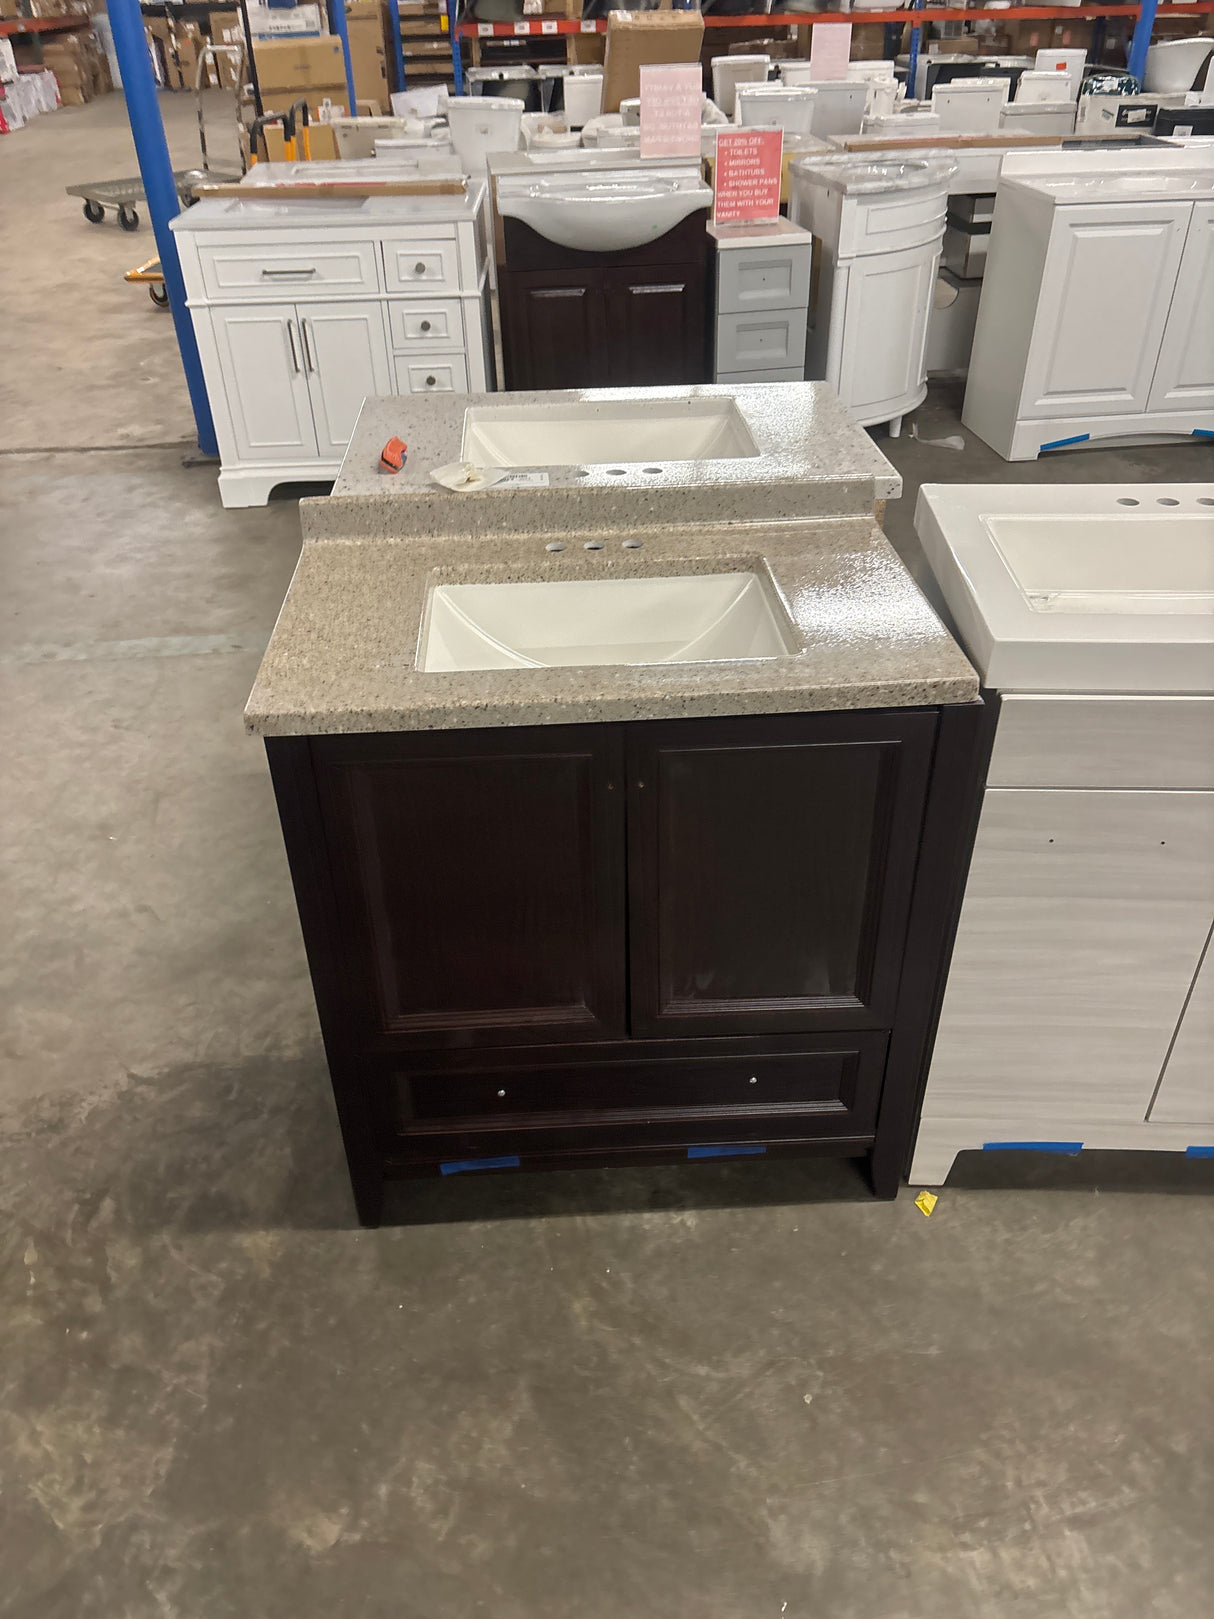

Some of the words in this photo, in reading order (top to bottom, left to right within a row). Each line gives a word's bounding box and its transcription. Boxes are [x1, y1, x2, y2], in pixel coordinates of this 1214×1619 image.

[718, 138, 732, 146] GET
[729, 147, 758, 155] TOILETS
[729, 158, 760, 166] MIRRORS
[729, 168, 765, 177] BATHTUBS
[729, 179, 758, 187] SHOWER
[759, 177, 778, 185] PANS
[739, 189, 753, 197] YOU
[754, 188, 768, 196] BUY
[718, 200, 736, 208] THEM
[737, 199, 754, 207] WITH
[755, 198, 774, 206] YOUR
[717, 210, 740, 218] VANITY
